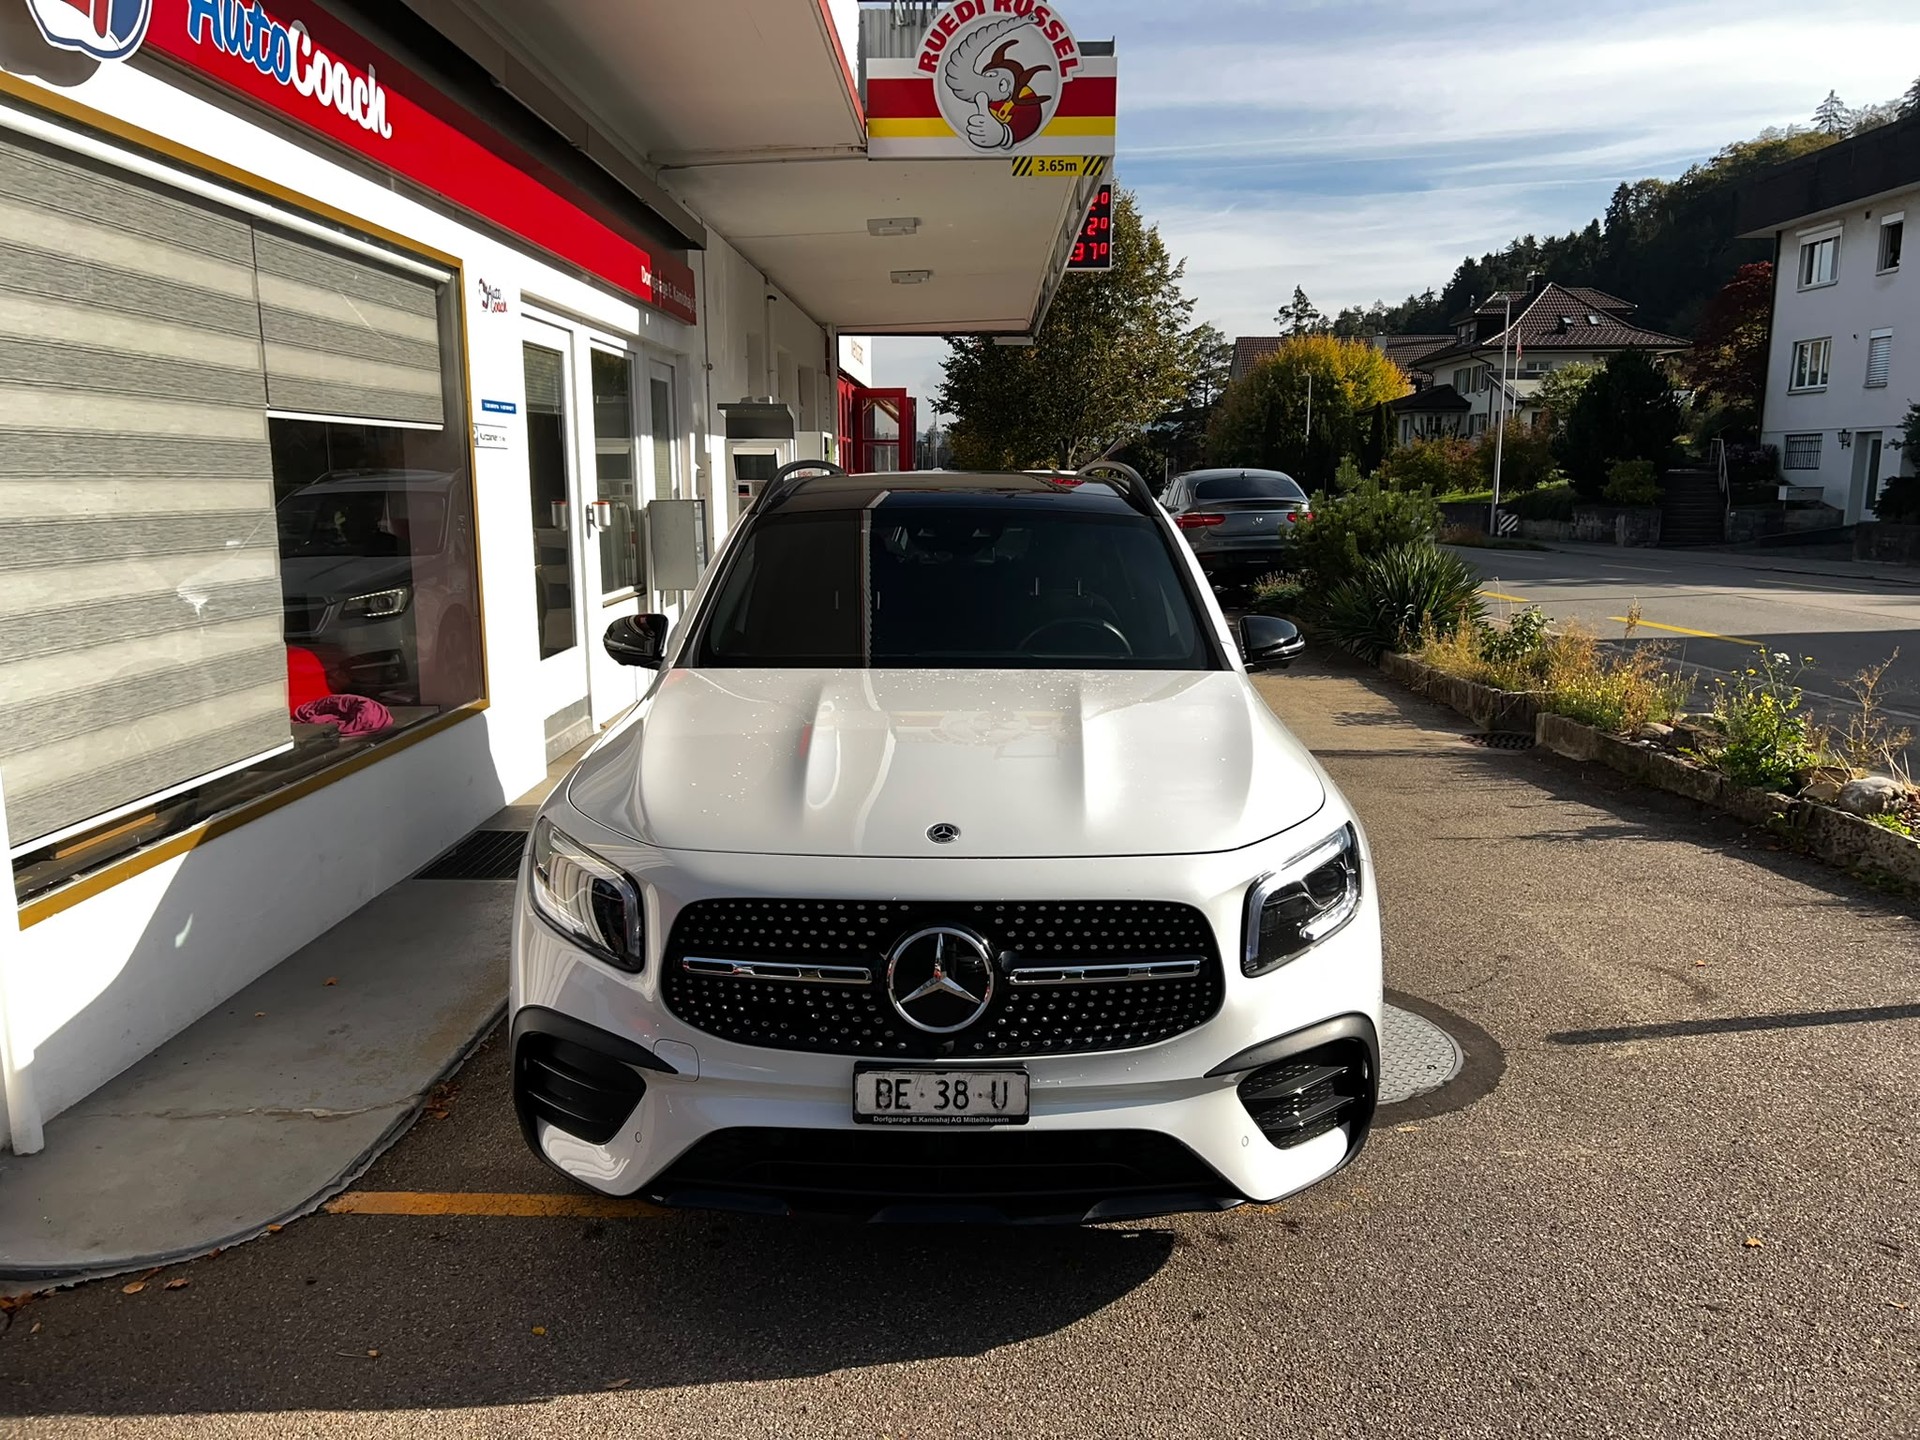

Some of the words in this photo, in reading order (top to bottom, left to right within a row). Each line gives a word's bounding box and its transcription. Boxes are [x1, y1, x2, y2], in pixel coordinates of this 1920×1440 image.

[918, 0, 986, 73] RUEDI
[1038, 159, 1078, 173] 3.65m
[875, 1078, 912, 1110] BE
[934, 1079, 969, 1110] 38
[991, 1080, 1008, 1110] U
[873, 1115, 911, 1124] Dorfgarage
